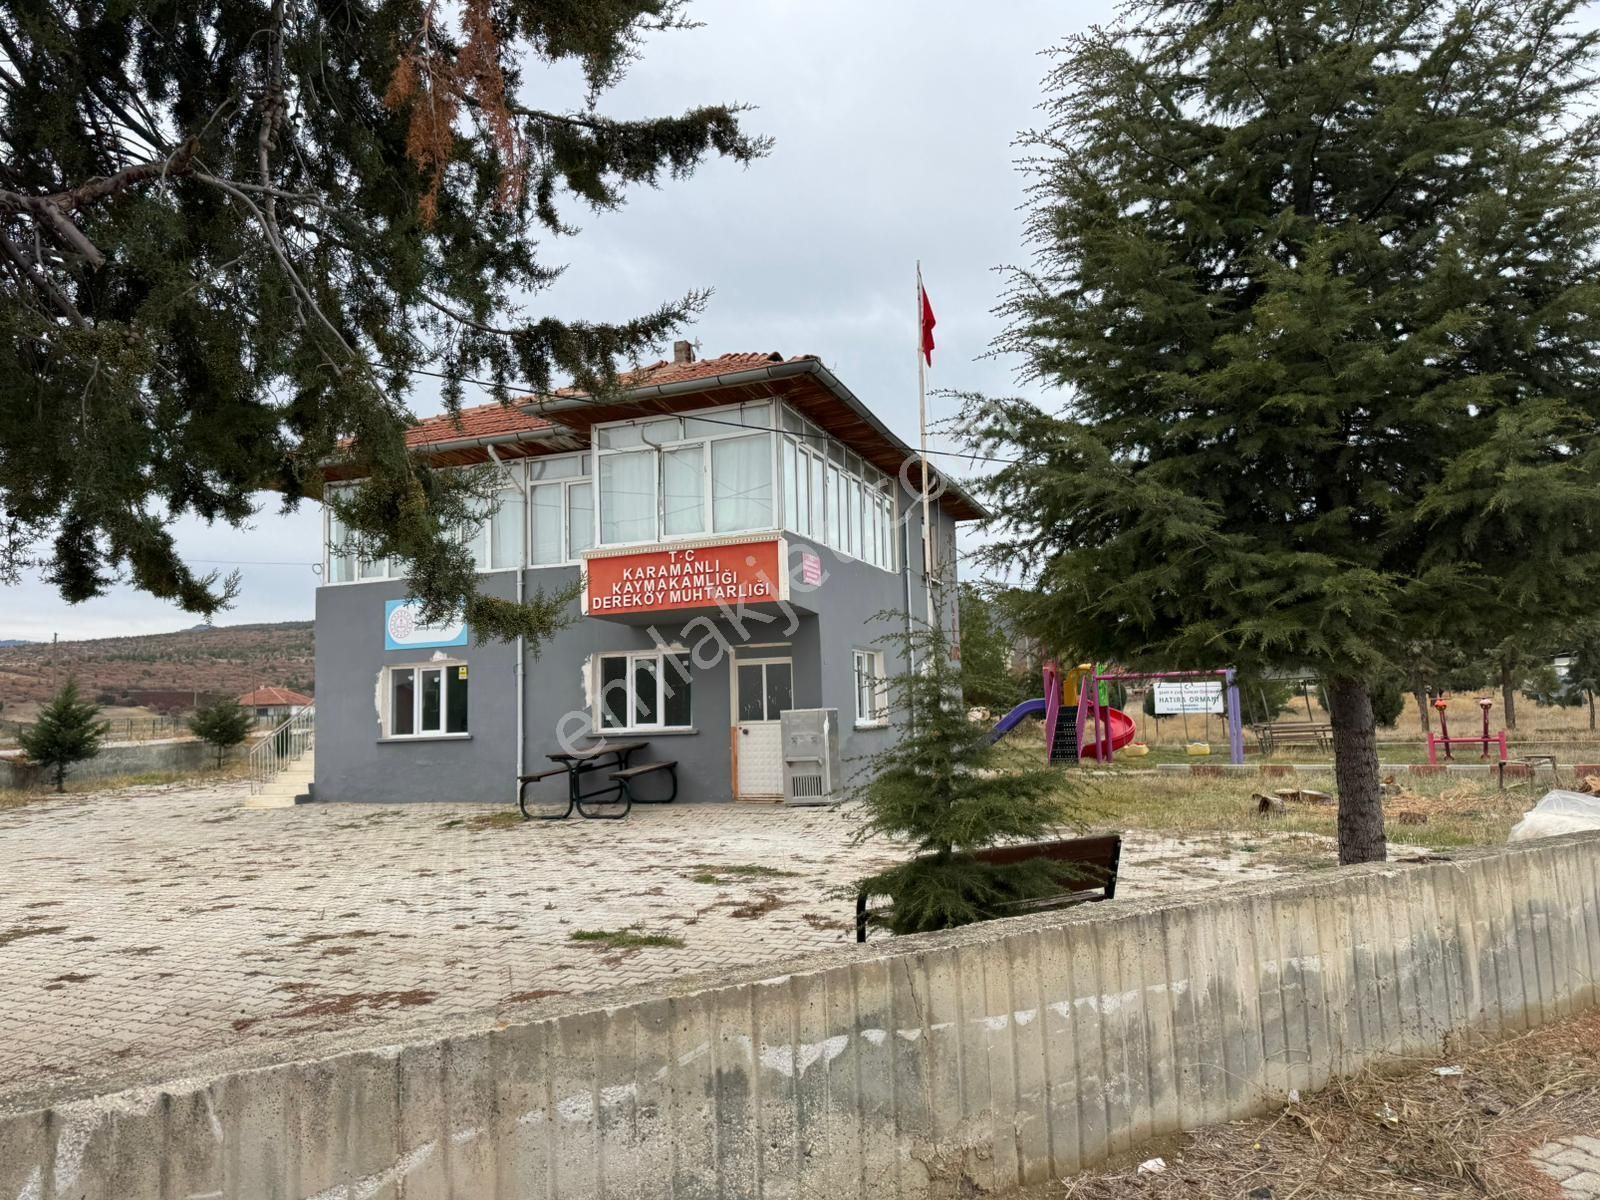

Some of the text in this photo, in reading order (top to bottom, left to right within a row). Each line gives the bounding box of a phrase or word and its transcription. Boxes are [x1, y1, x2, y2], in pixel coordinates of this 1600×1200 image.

[612, 568, 737, 595] KAYMAKAMLIĞI
[623, 559, 719, 581] KARAMANLI
[592, 579, 769, 610] DEREKÖY MUHTARLIĞI
